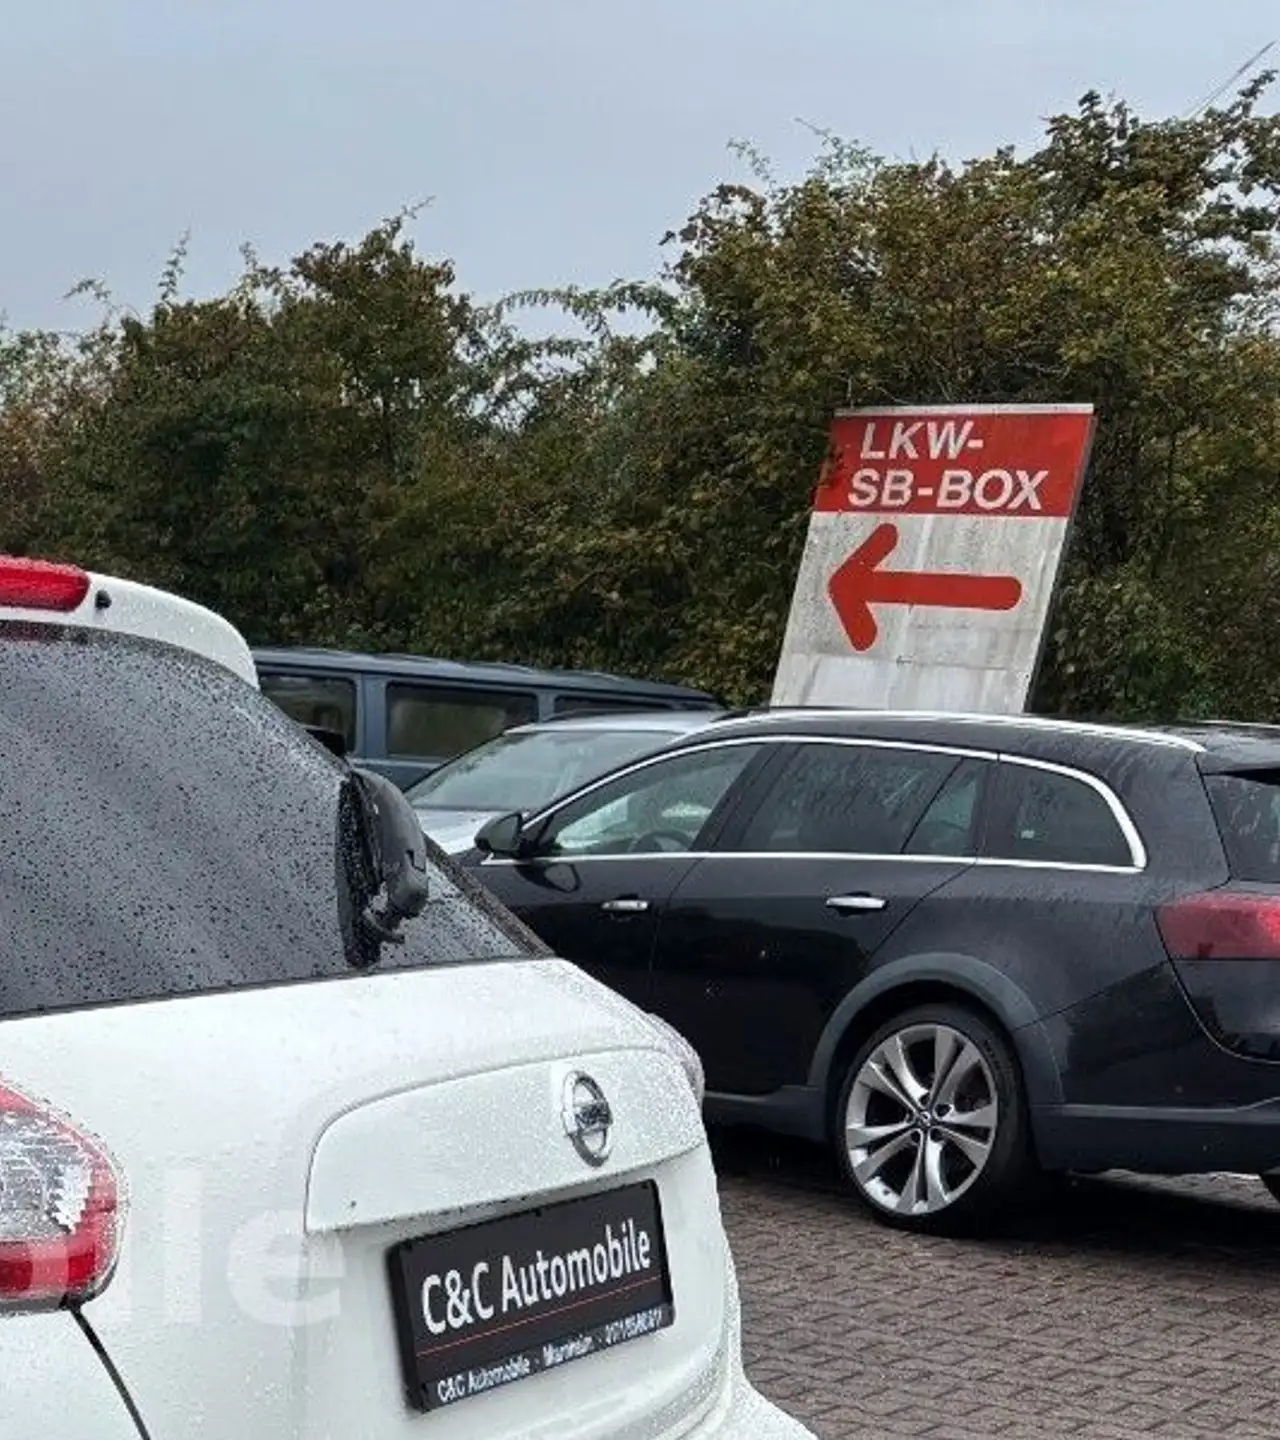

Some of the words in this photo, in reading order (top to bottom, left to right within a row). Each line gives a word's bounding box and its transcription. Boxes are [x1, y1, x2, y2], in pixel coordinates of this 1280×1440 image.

[860, 420, 984, 461] LKW-
[847, 467, 1049, 511] SB-BOX
[421, 1261, 495, 1335] C&C
[501, 1217, 651, 1313] Automobile
